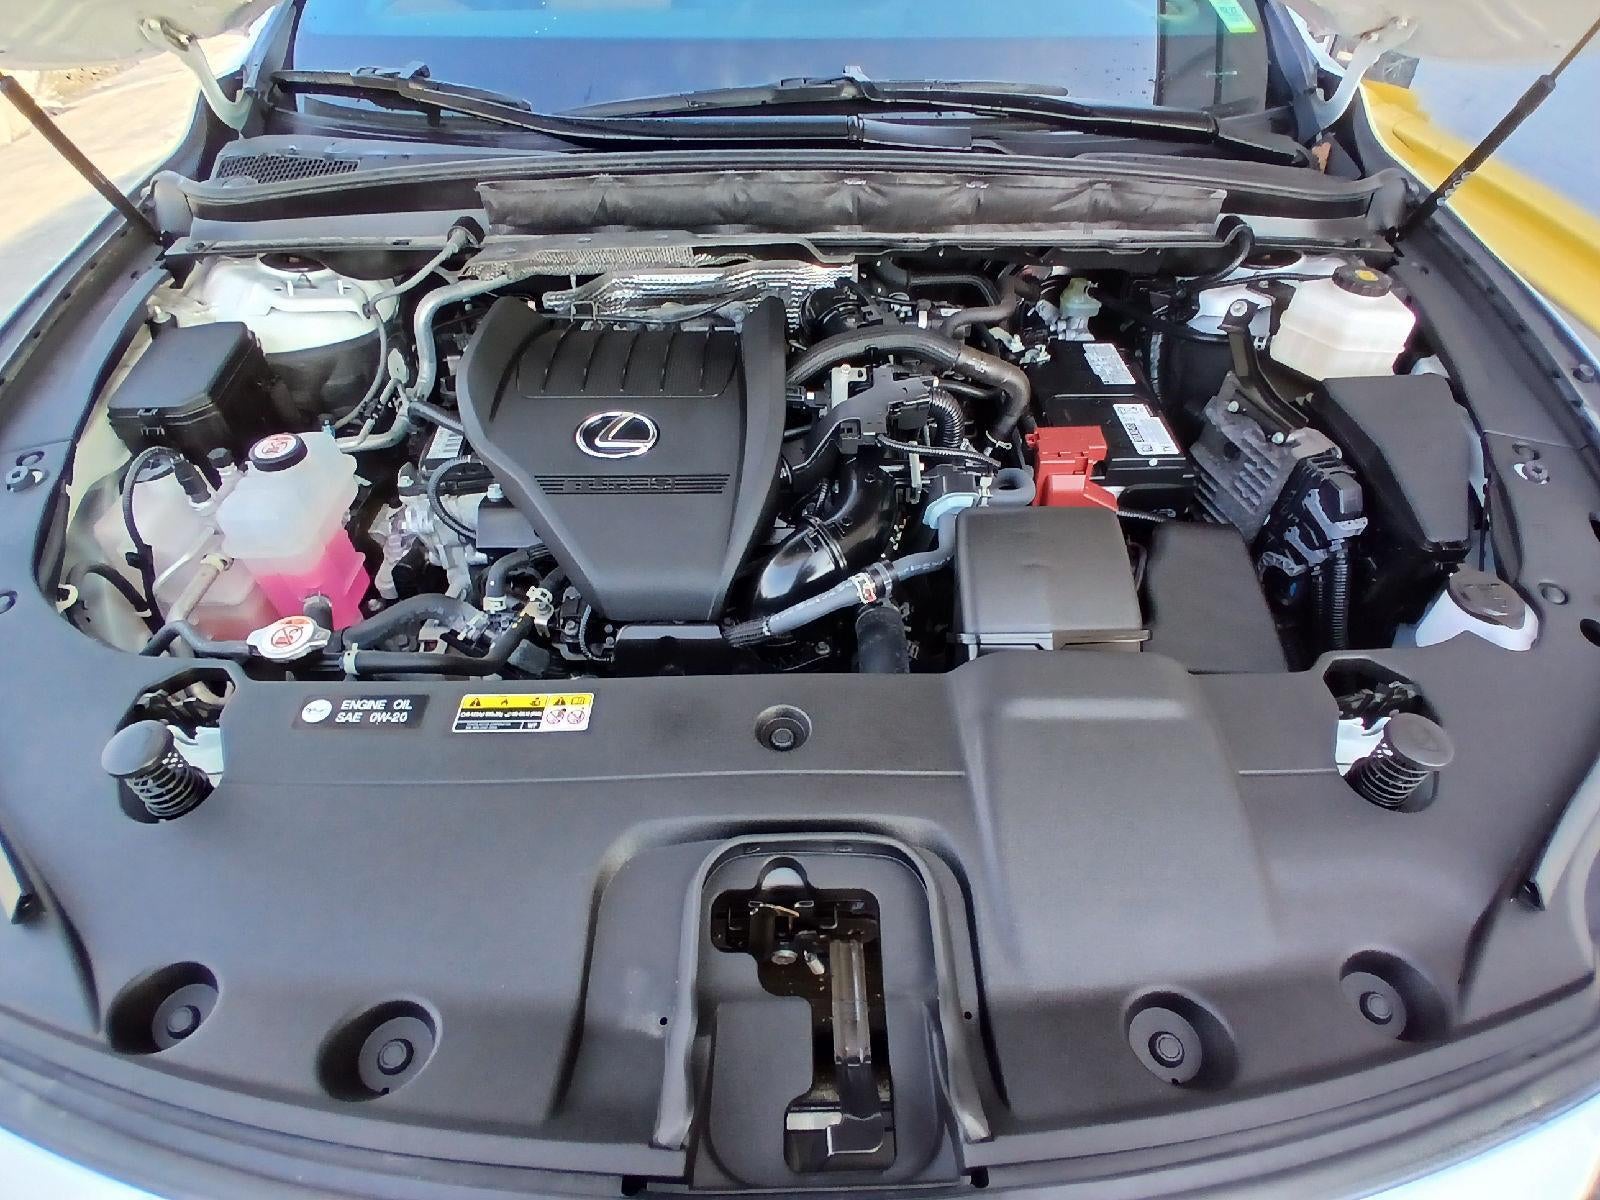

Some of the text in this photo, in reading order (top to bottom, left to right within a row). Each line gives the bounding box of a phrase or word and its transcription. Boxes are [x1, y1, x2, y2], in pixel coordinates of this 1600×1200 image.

[340, 699, 413, 710] ENGINE OIL
[335, 711, 408, 724] SAE 0W-20
